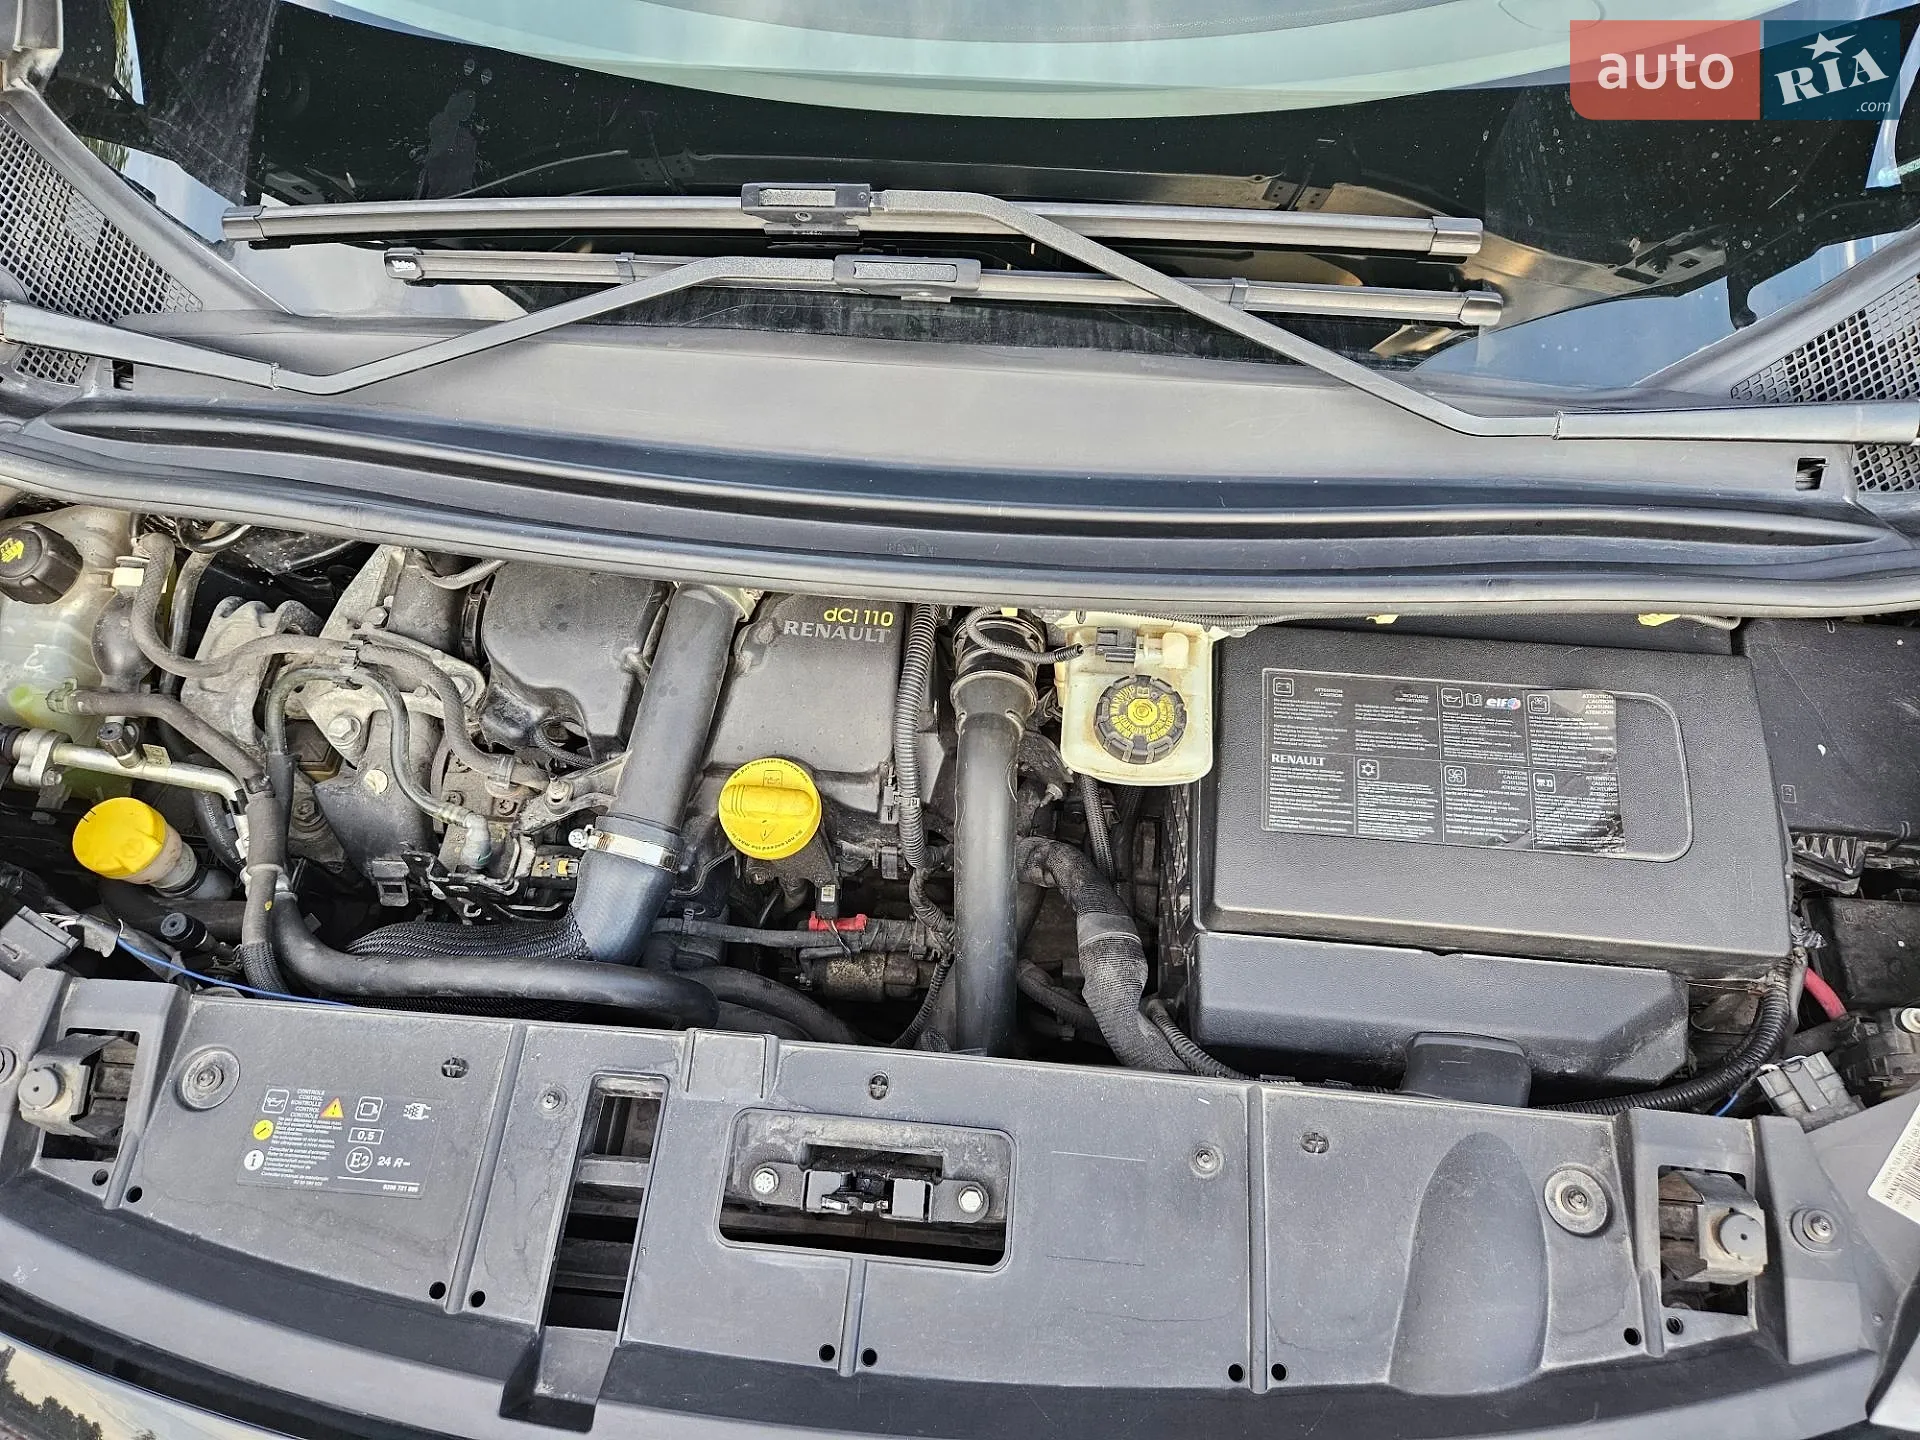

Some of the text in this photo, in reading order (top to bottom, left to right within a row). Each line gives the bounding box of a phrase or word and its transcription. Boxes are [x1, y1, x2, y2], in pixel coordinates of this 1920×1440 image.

[823, 607, 894, 627] dCi 110
[783, 620, 891, 643] RENAULT
[1486, 697, 1509, 707] elf
[1271, 753, 1326, 766] RENAULT
[357, 1130, 376, 1142] 0,5
[377, 1156, 392, 1168] 24
